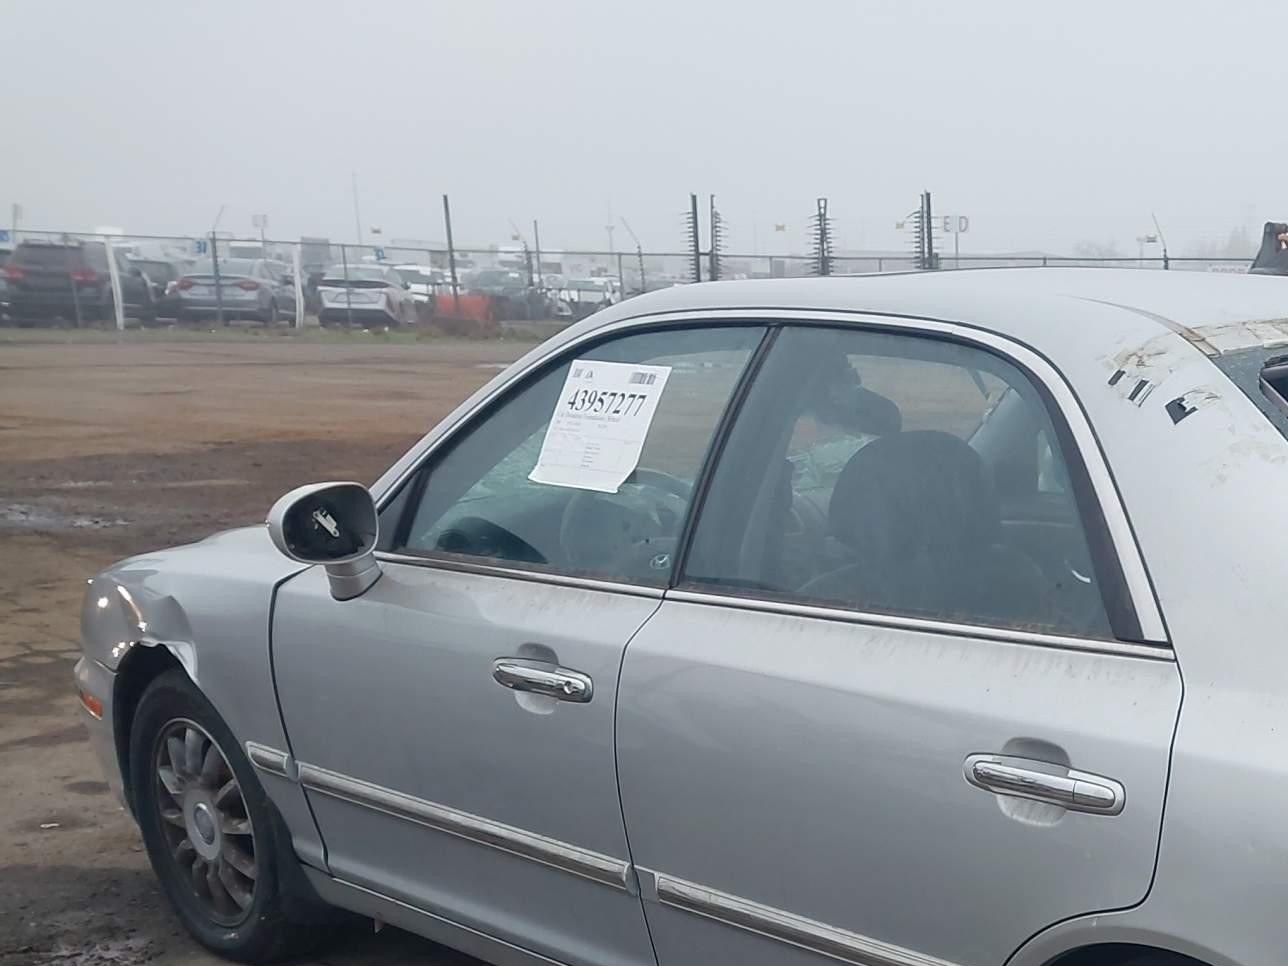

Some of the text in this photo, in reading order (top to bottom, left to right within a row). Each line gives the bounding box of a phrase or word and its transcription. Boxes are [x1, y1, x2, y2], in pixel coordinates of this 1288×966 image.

[943, 215, 969, 233] E D
[567, 388, 648, 417] 43957277
